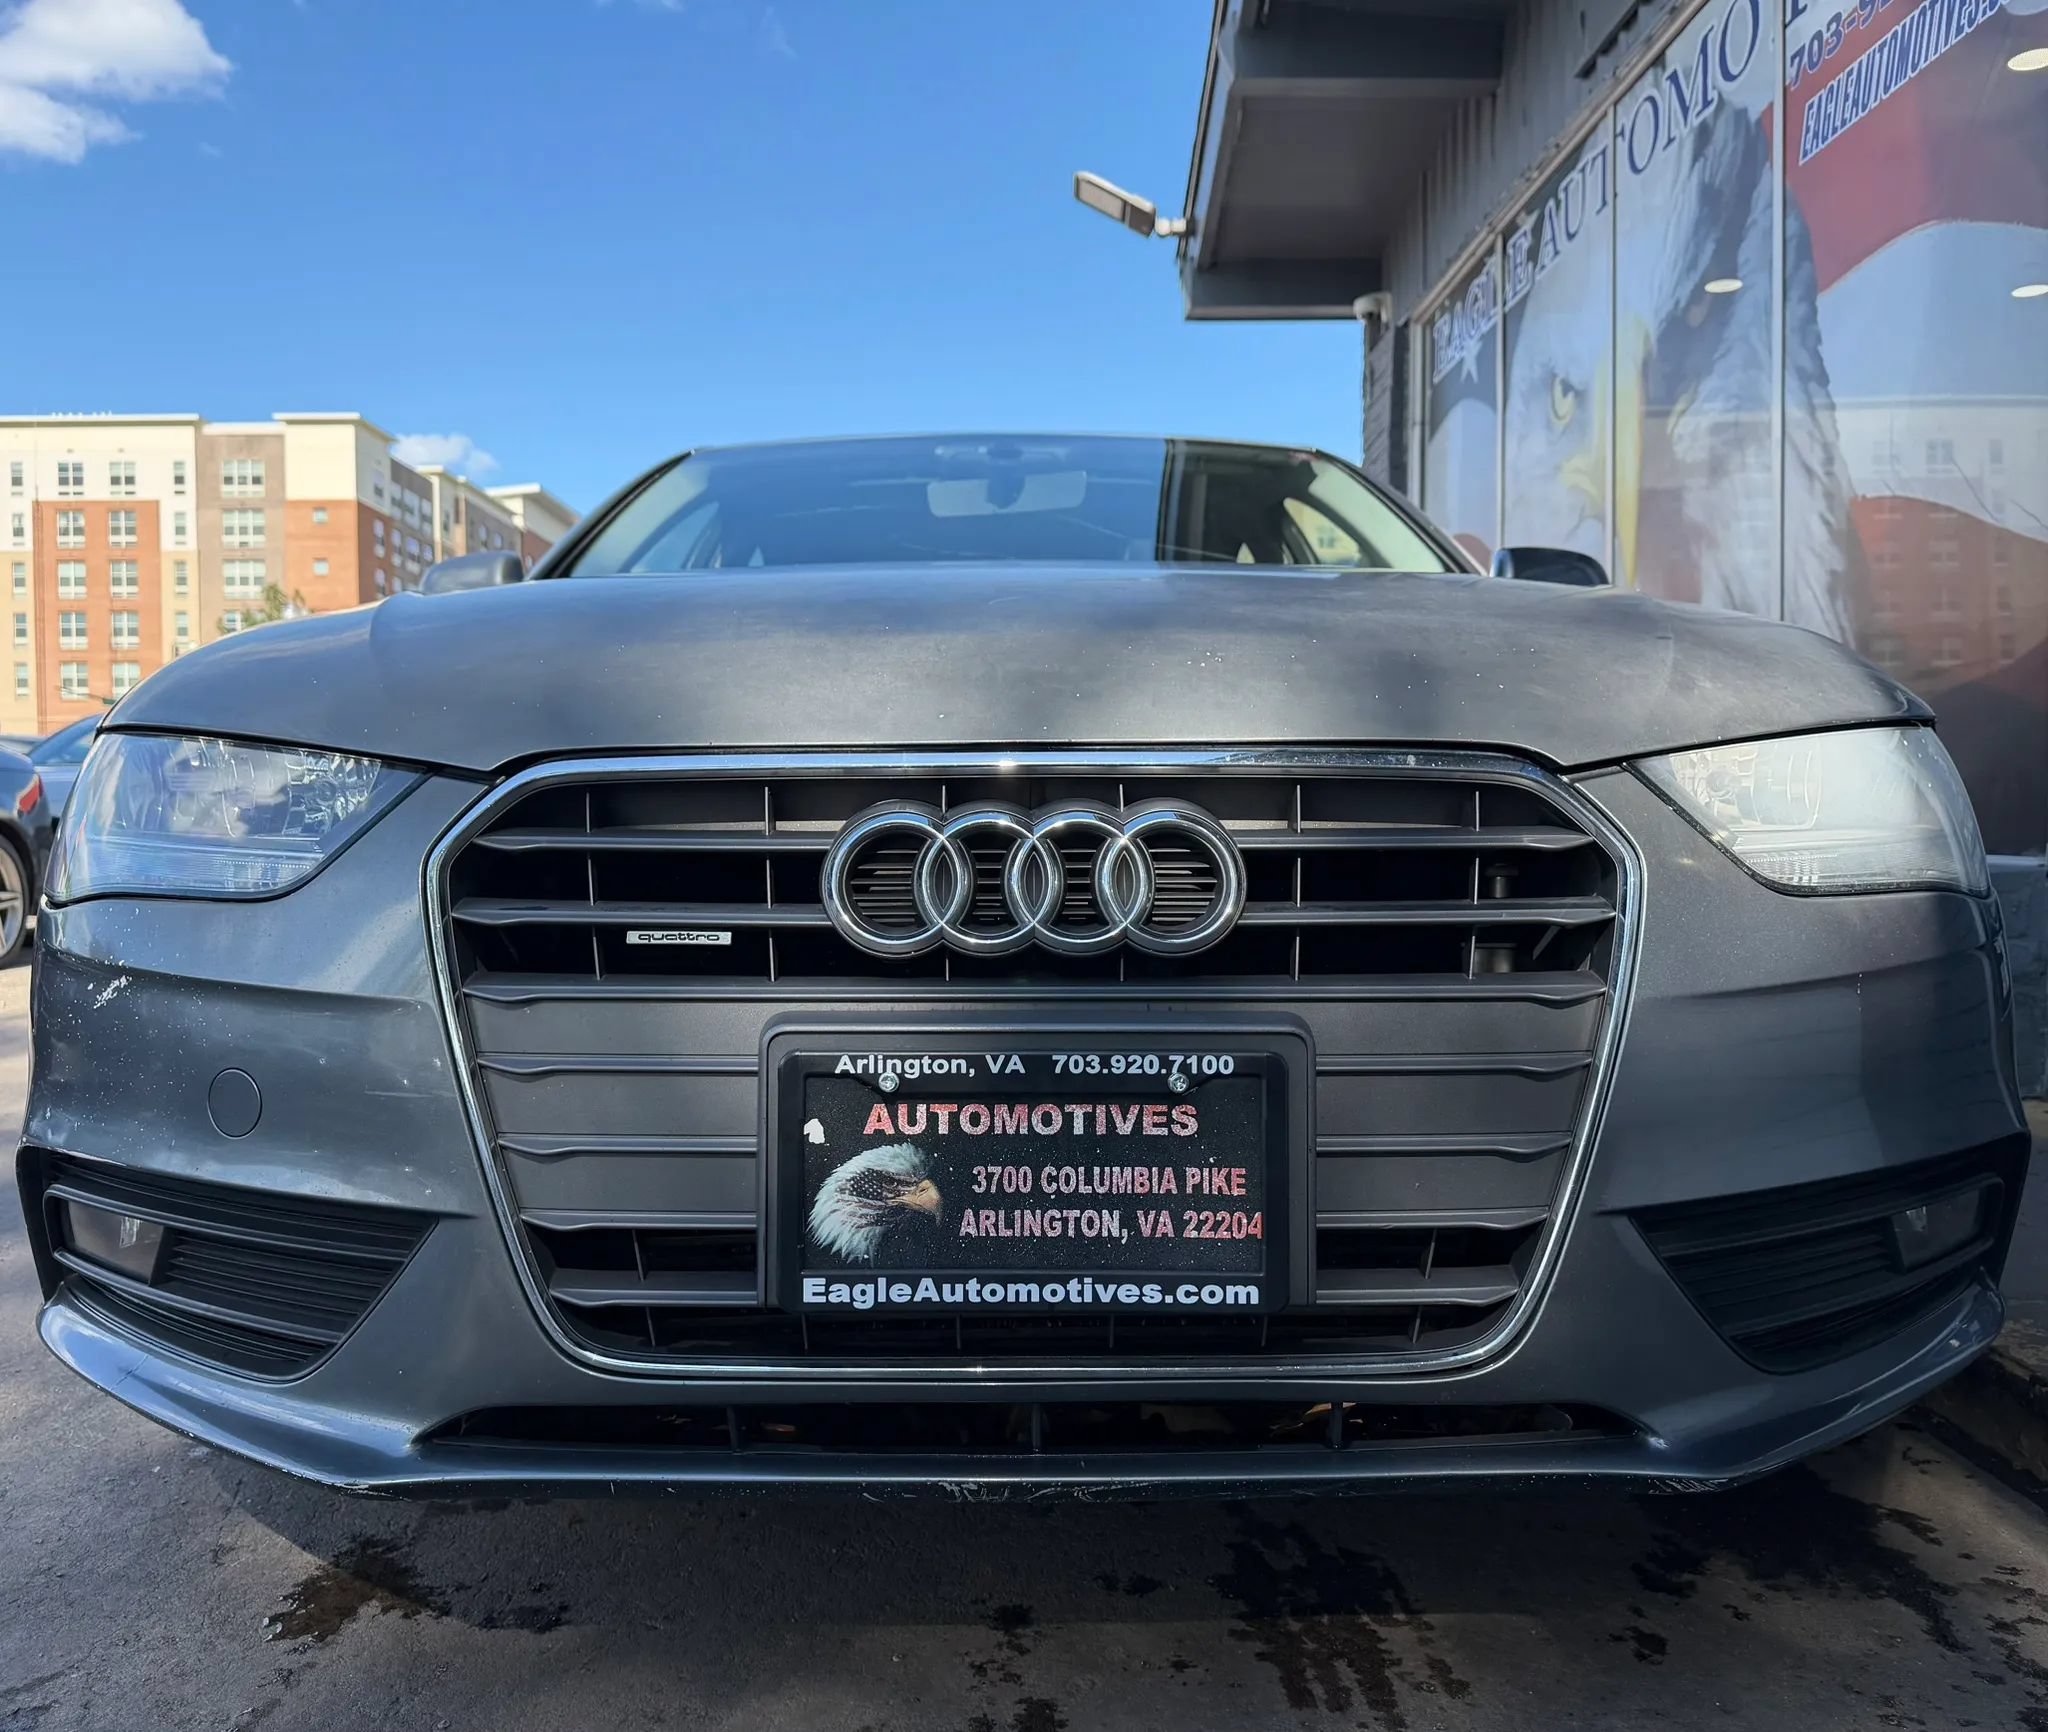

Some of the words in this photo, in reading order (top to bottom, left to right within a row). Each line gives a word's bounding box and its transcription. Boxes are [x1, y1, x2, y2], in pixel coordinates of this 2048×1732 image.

[637, 932, 720, 943] quattro
[834, 1054, 976, 1079] Arlington,
[985, 1054, 1027, 1074] VA
[1052, 1054, 1235, 1075] 703.920.7100
[862, 1103, 1199, 1136] AUTOMOTIVES
[971, 1166, 1033, 1194] 3700
[1041, 1166, 1178, 1195] COLUMBIA
[1186, 1167, 1248, 1196] PIKE
[959, 1208, 1129, 1244] ARLINGTON,
[1137, 1210, 1176, 1238] VA
[1183, 1210, 1264, 1240] 22204
[802, 1277, 1260, 1310] EagleAutomotives.com
